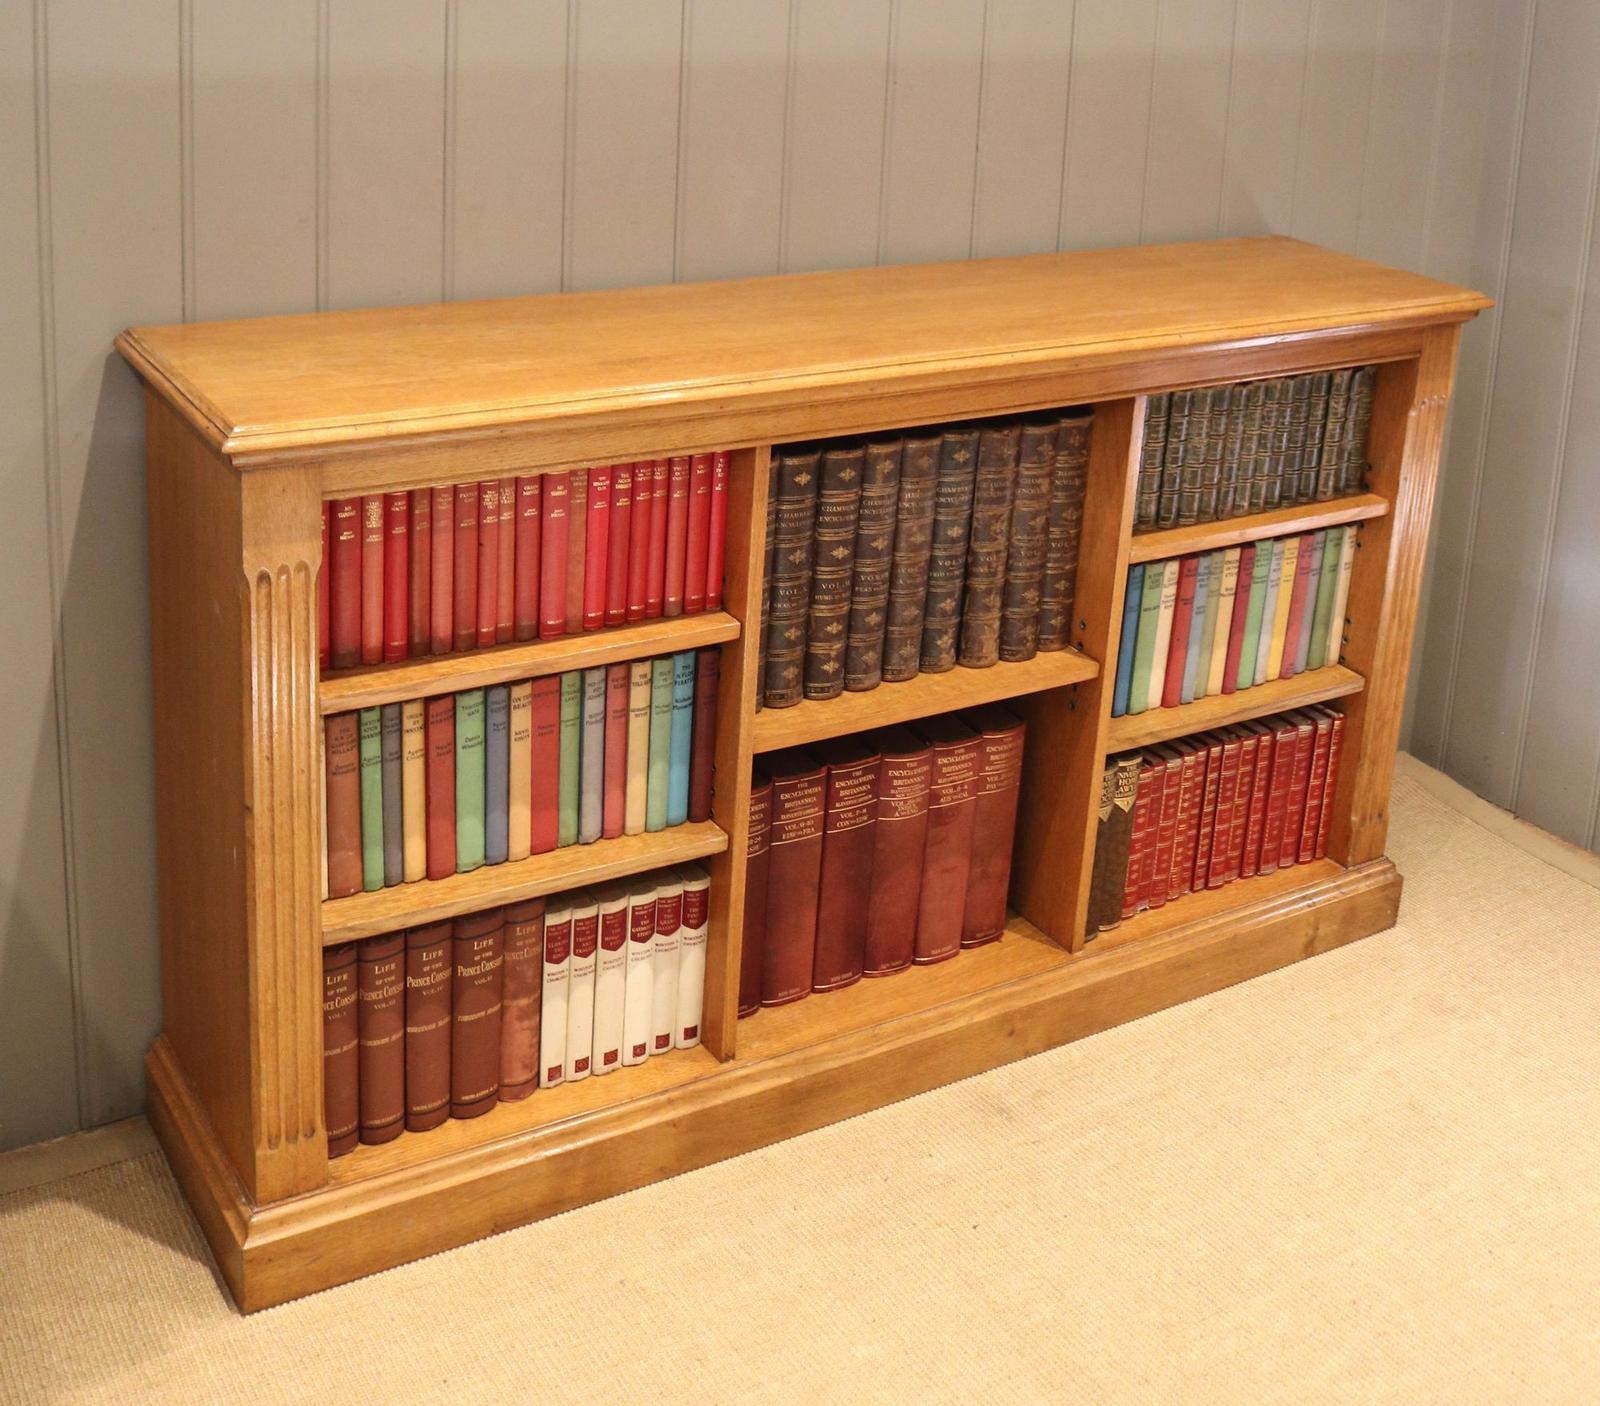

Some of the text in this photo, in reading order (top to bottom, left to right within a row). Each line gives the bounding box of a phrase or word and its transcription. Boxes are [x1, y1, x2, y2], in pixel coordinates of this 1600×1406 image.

[473, 938, 494, 950] LIFE
[423, 949, 443, 961] LIFE
[375, 962, 397, 975] LIFE
[327, 973, 348, 985] LIFE
